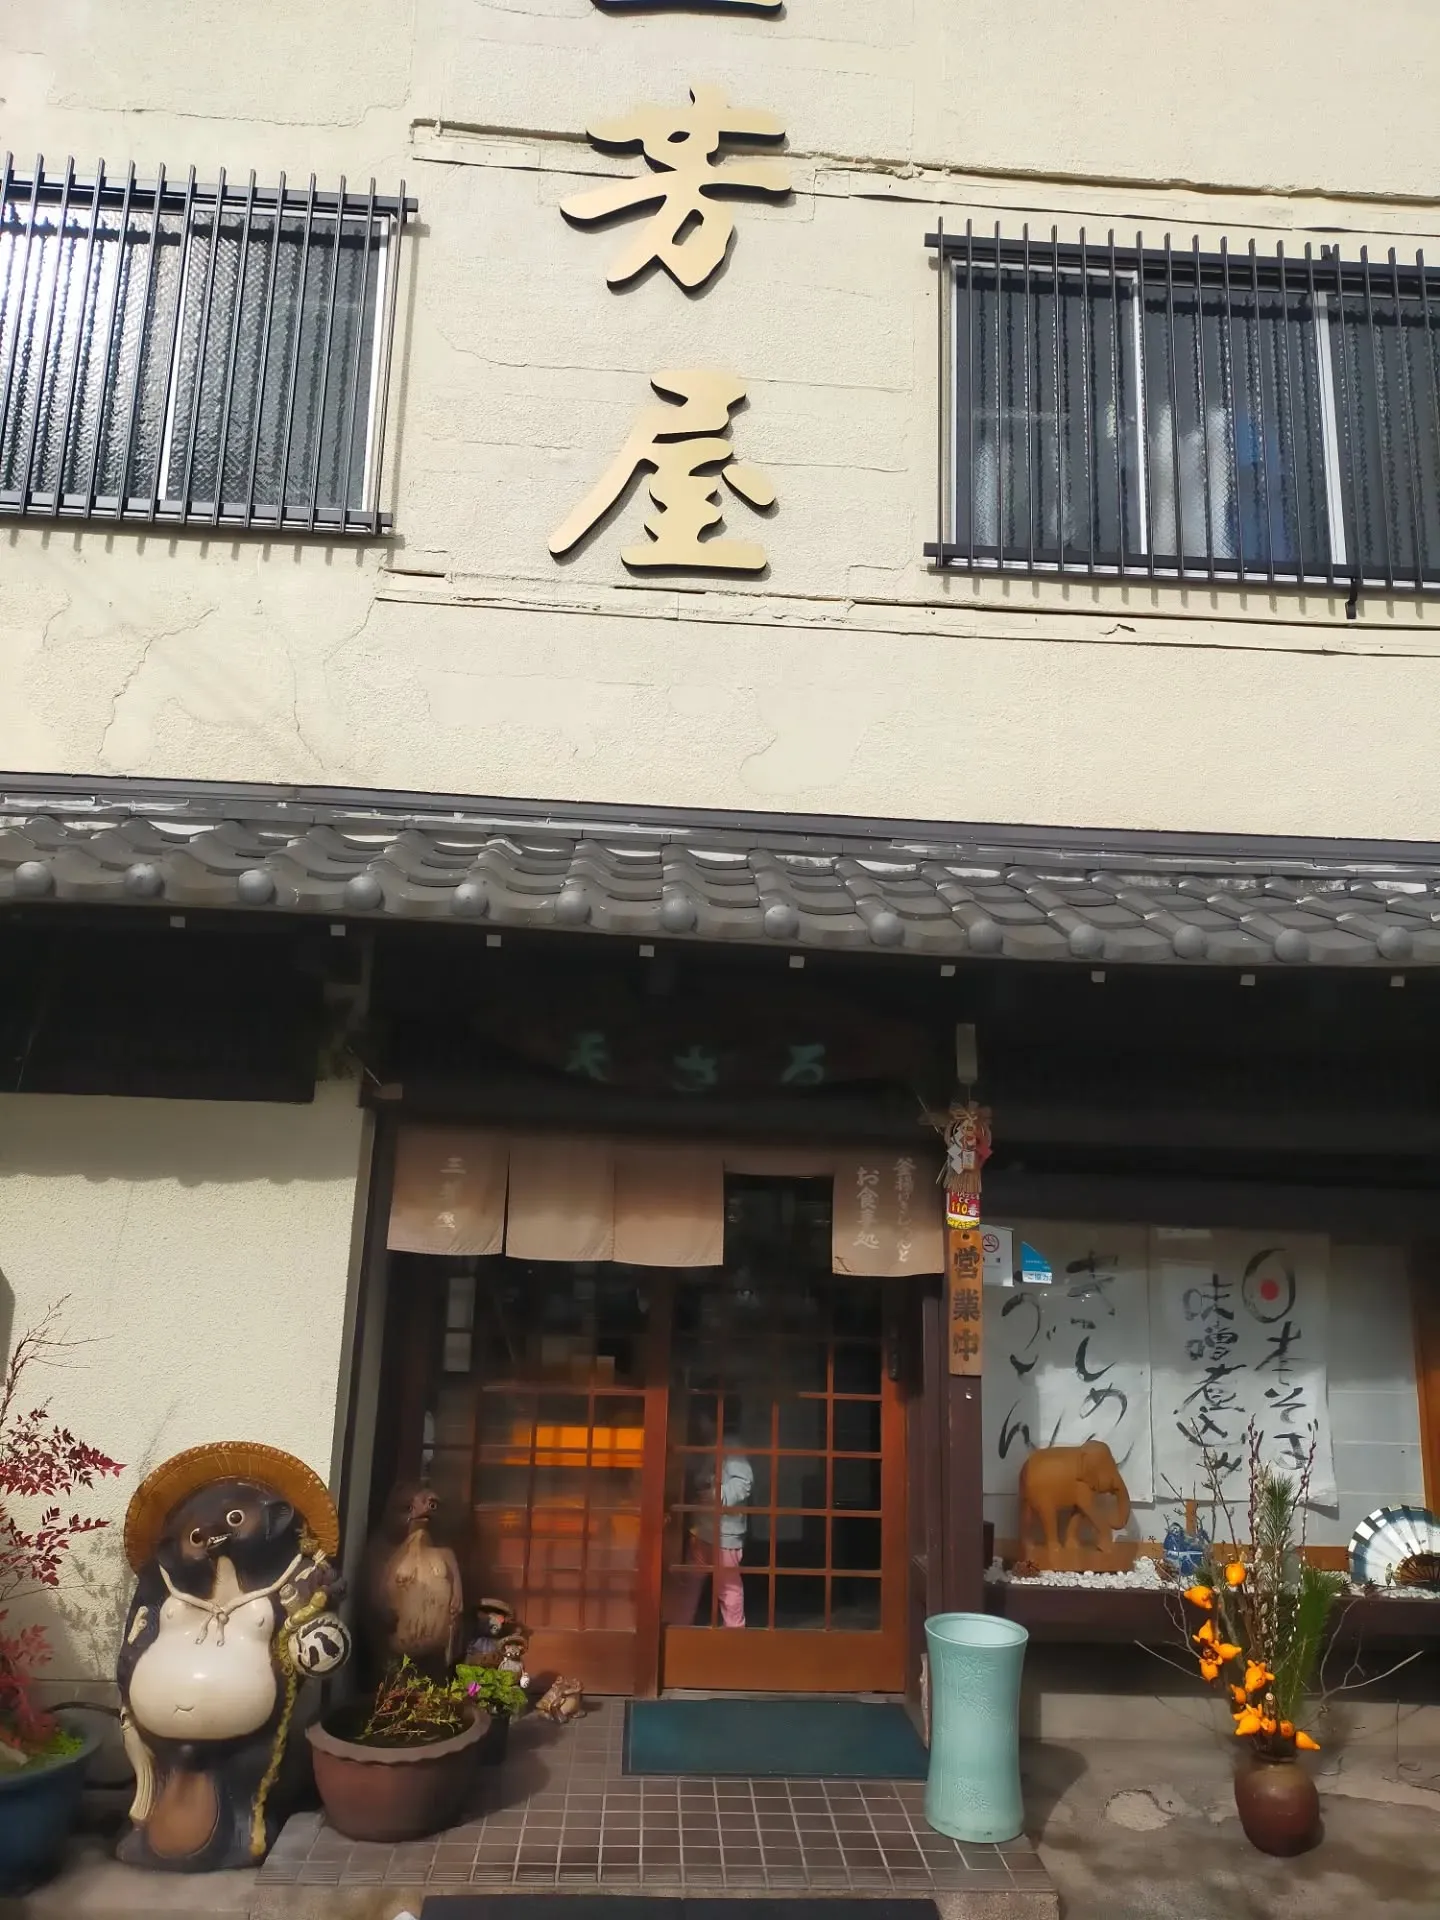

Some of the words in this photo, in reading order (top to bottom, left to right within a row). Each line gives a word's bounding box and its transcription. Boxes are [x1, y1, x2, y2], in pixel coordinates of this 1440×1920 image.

[548, 0, 792, 574] 芳屋
[852, 1166, 880, 1250] お食事処
[954, 1245, 982, 1361] 営業中
